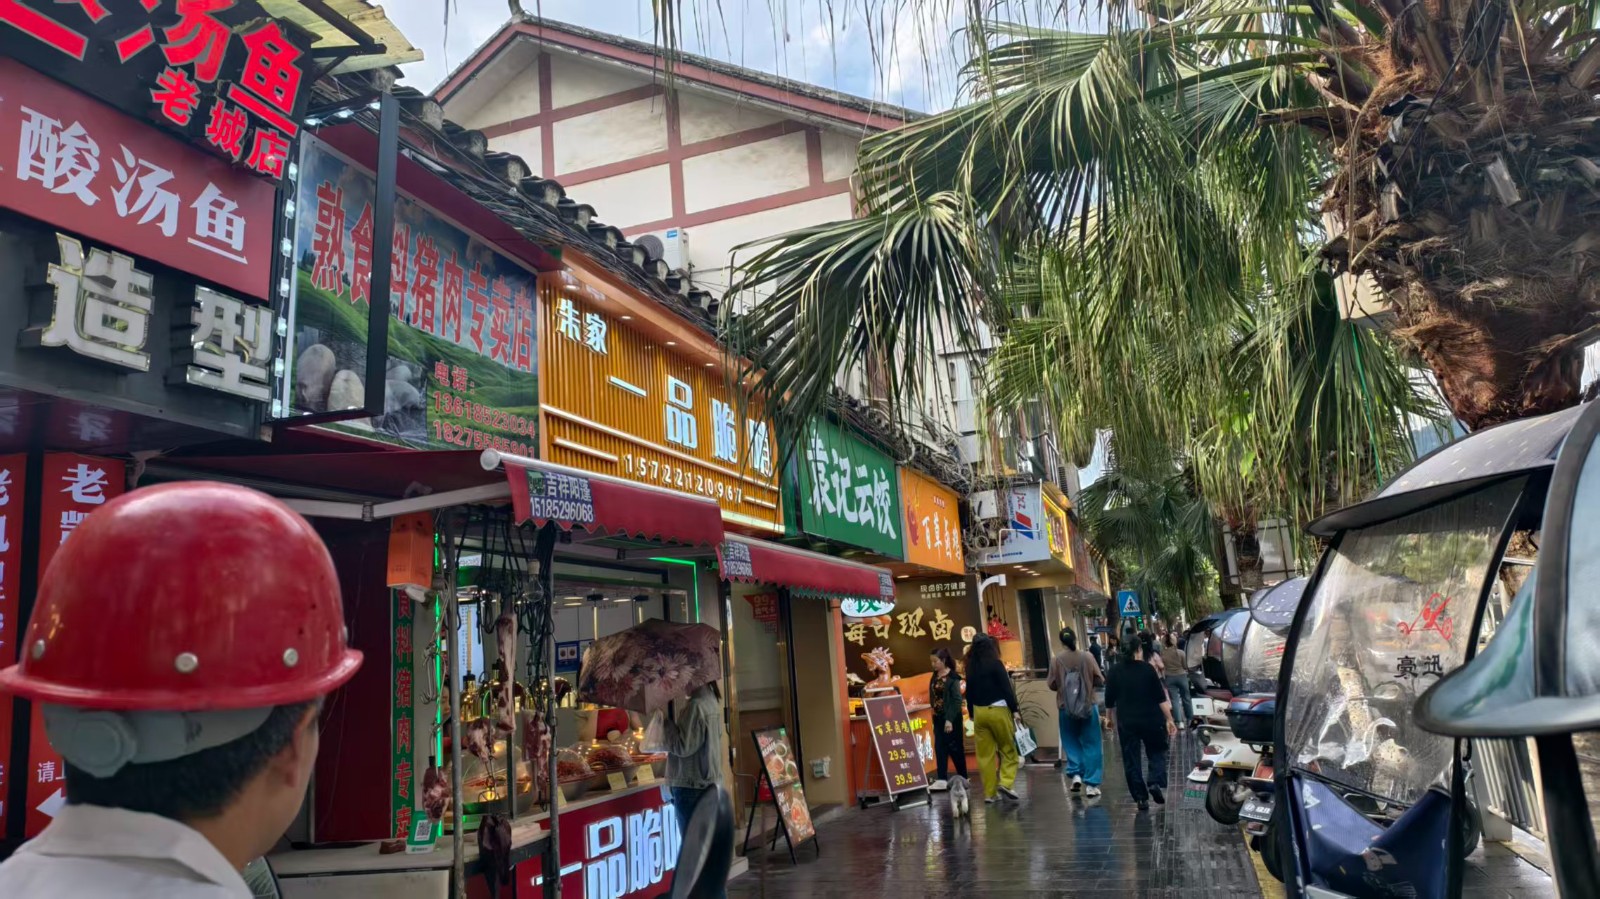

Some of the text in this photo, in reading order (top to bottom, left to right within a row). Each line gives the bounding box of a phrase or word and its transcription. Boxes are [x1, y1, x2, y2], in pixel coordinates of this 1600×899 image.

[150, 66, 290, 180] 老城店
[16, 105, 249, 265] 酸汤鱼
[40, 231, 275, 401] 造型
[555, 297, 608, 355] 朱家
[433, 390, 535, 439] 13618523034
[545, 472, 592, 502] 吉祥阳篷
[624, 453, 742, 504] 15722120967
[806, 428, 897, 540] 袁记云饺
[530, 497, 594, 522] 15185296068
